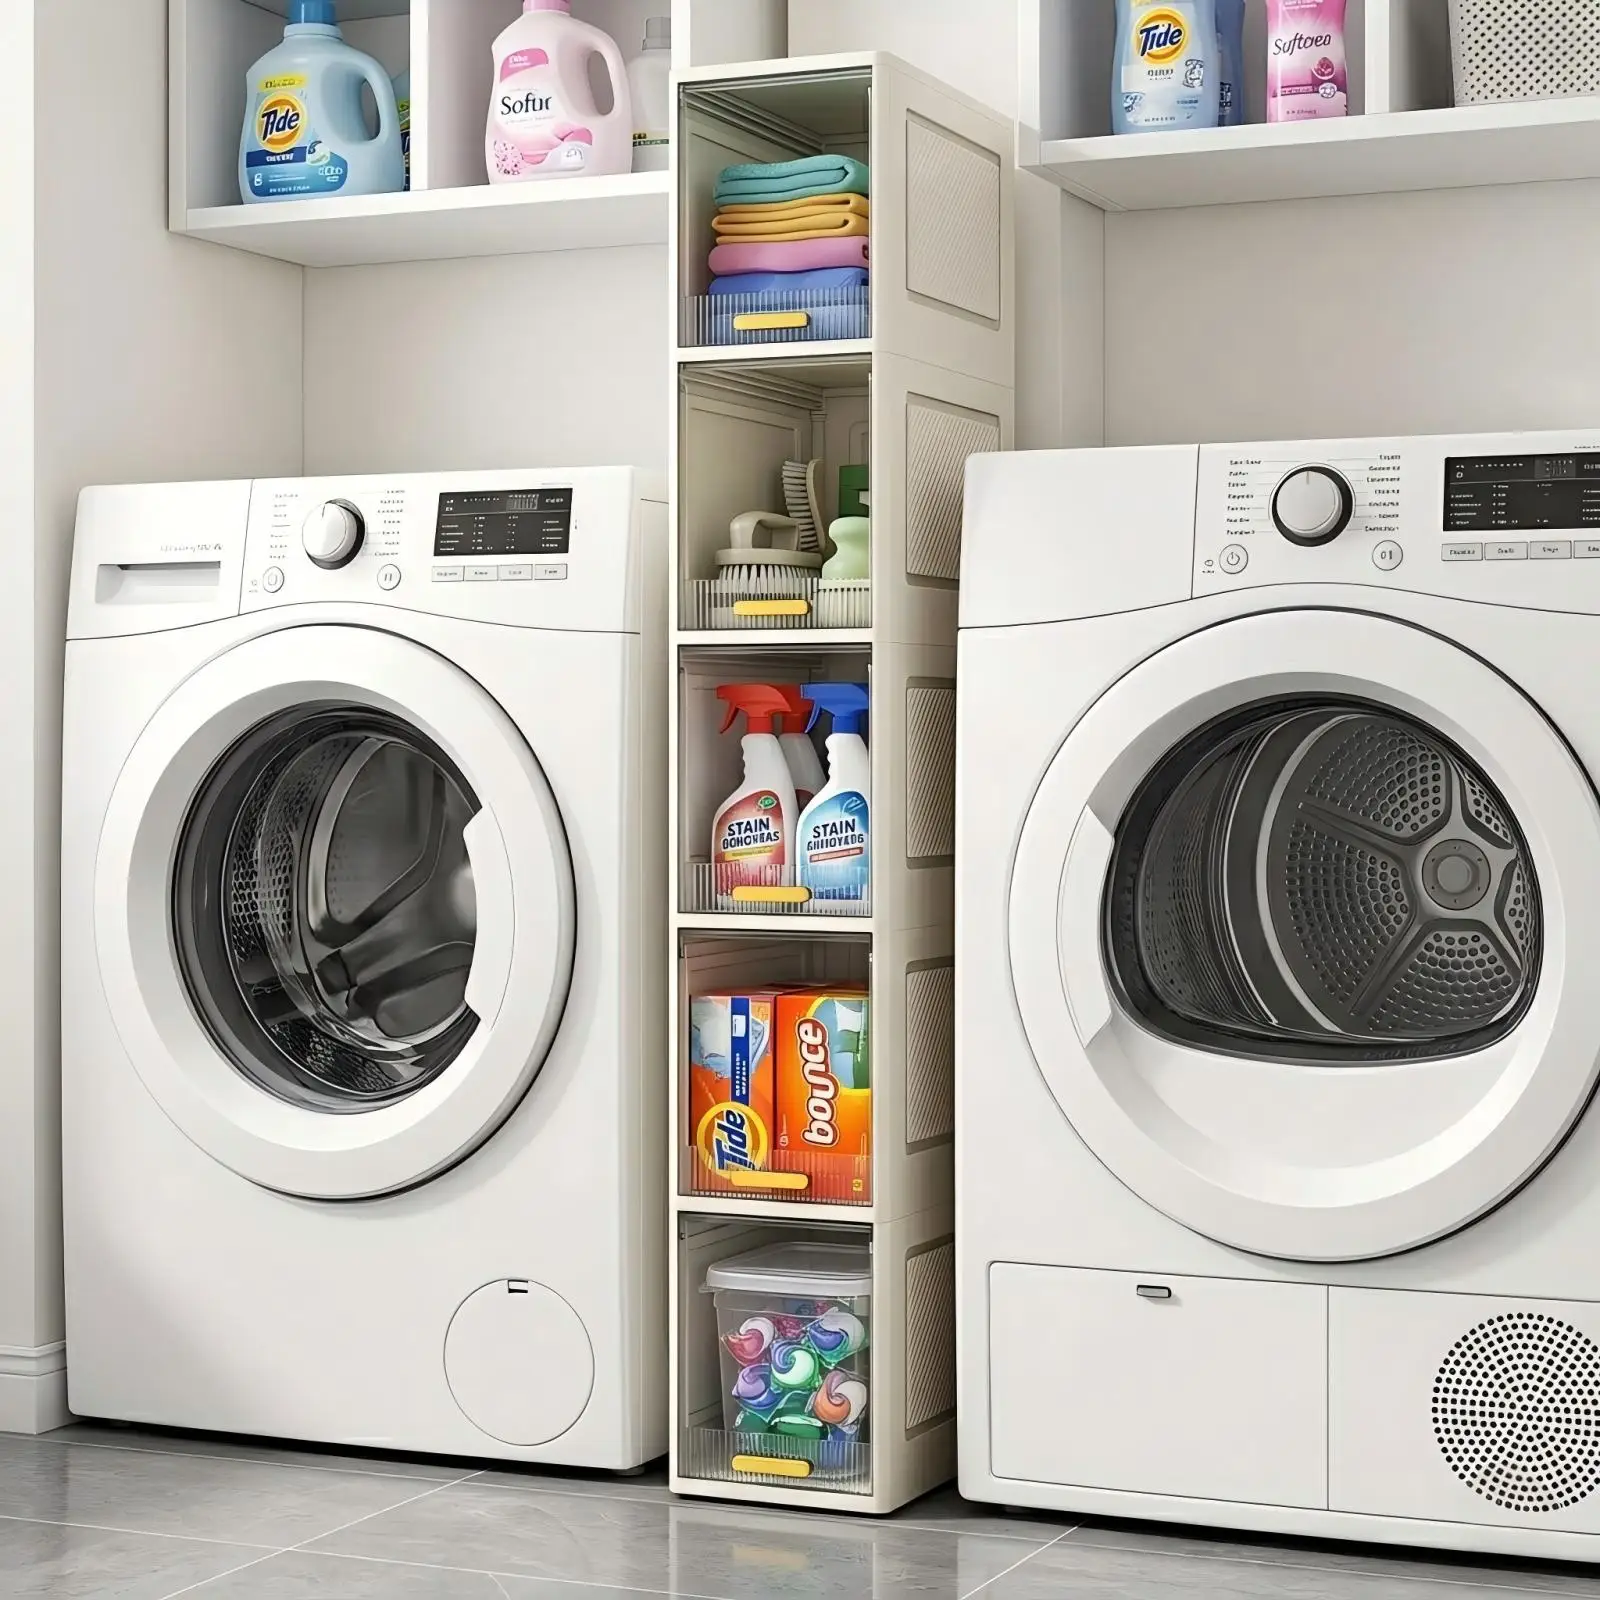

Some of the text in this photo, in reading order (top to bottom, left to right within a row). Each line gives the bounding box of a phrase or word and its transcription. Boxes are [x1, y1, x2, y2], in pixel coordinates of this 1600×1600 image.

[1140, 23, 1182, 56] Tide
[728, 817, 769, 836] STAIN
[813, 818, 855, 838] STAIN
[799, 1019, 838, 1146] bounce
[715, 1109, 755, 1171] Tide
